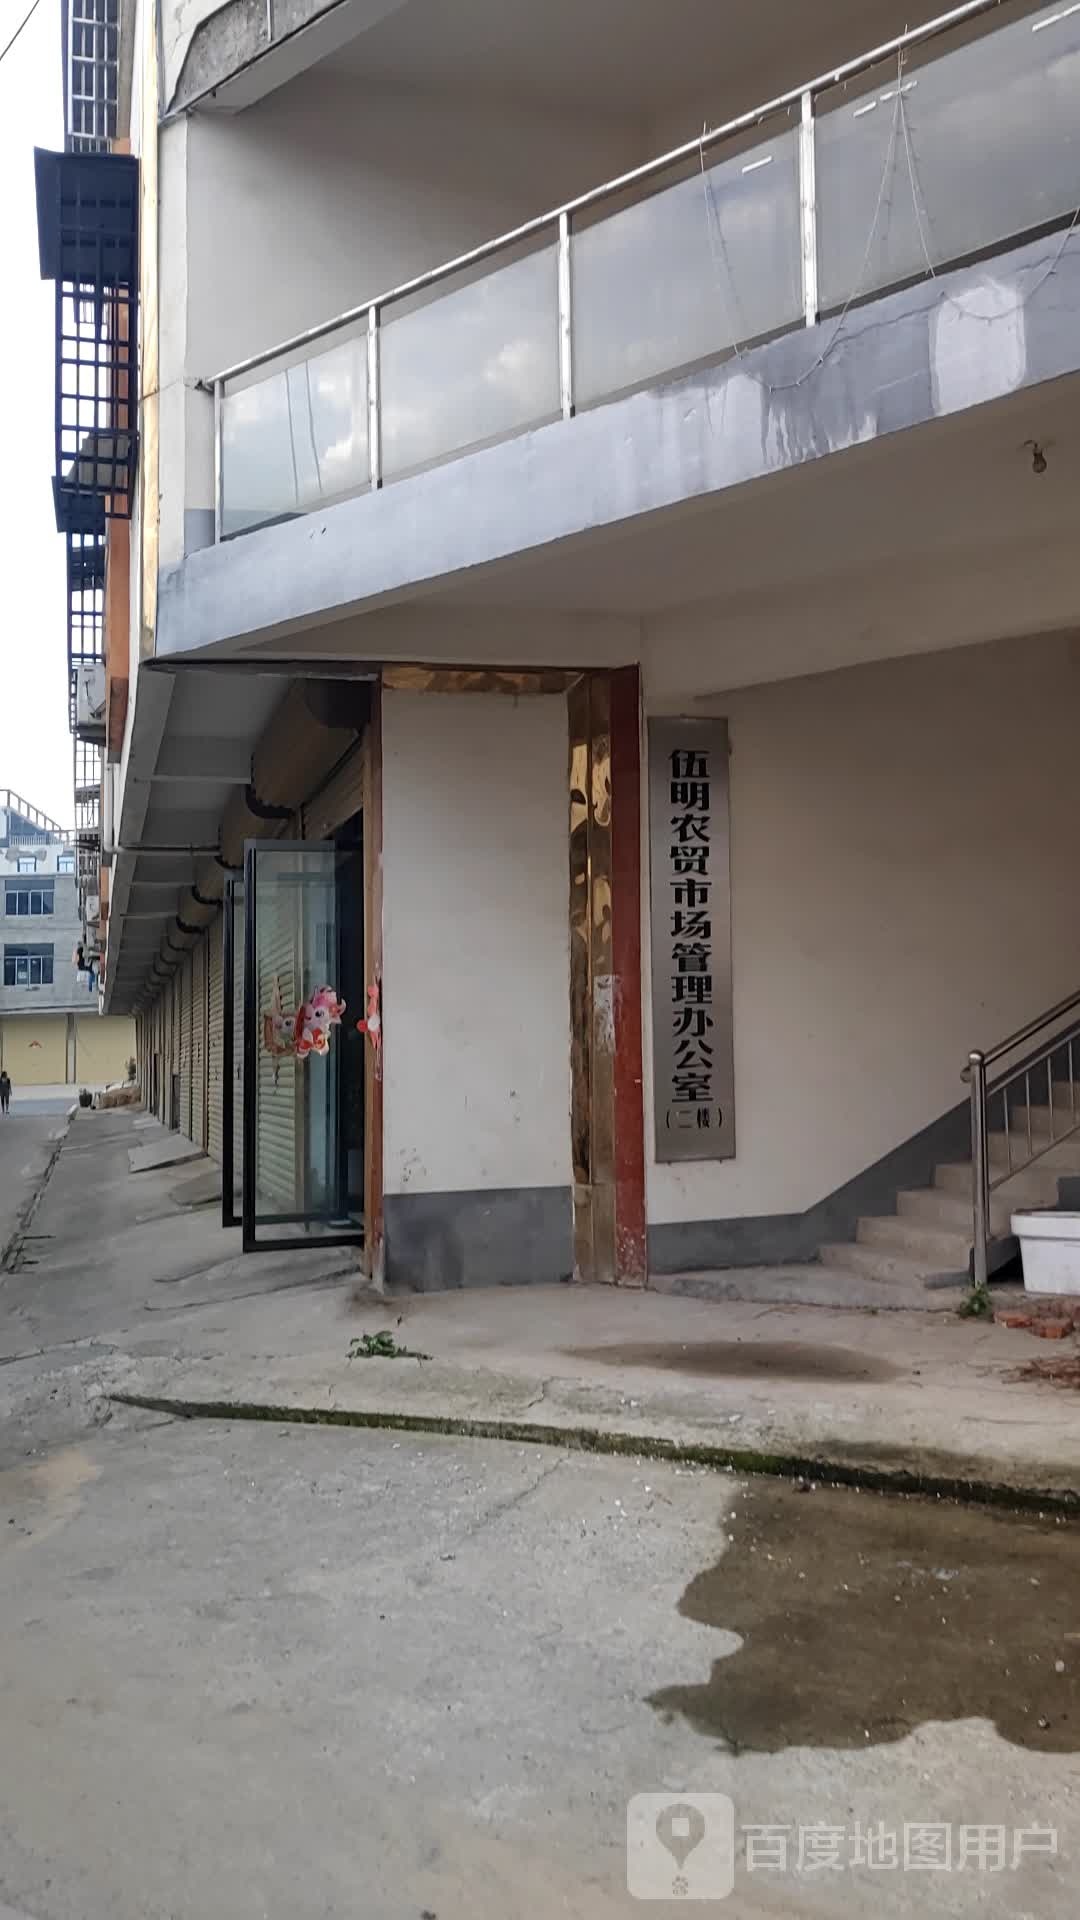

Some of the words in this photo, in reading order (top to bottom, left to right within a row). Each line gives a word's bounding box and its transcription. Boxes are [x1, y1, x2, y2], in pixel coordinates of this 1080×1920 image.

[669, 749, 714, 1103] 伍明农贸市场管理办公室
